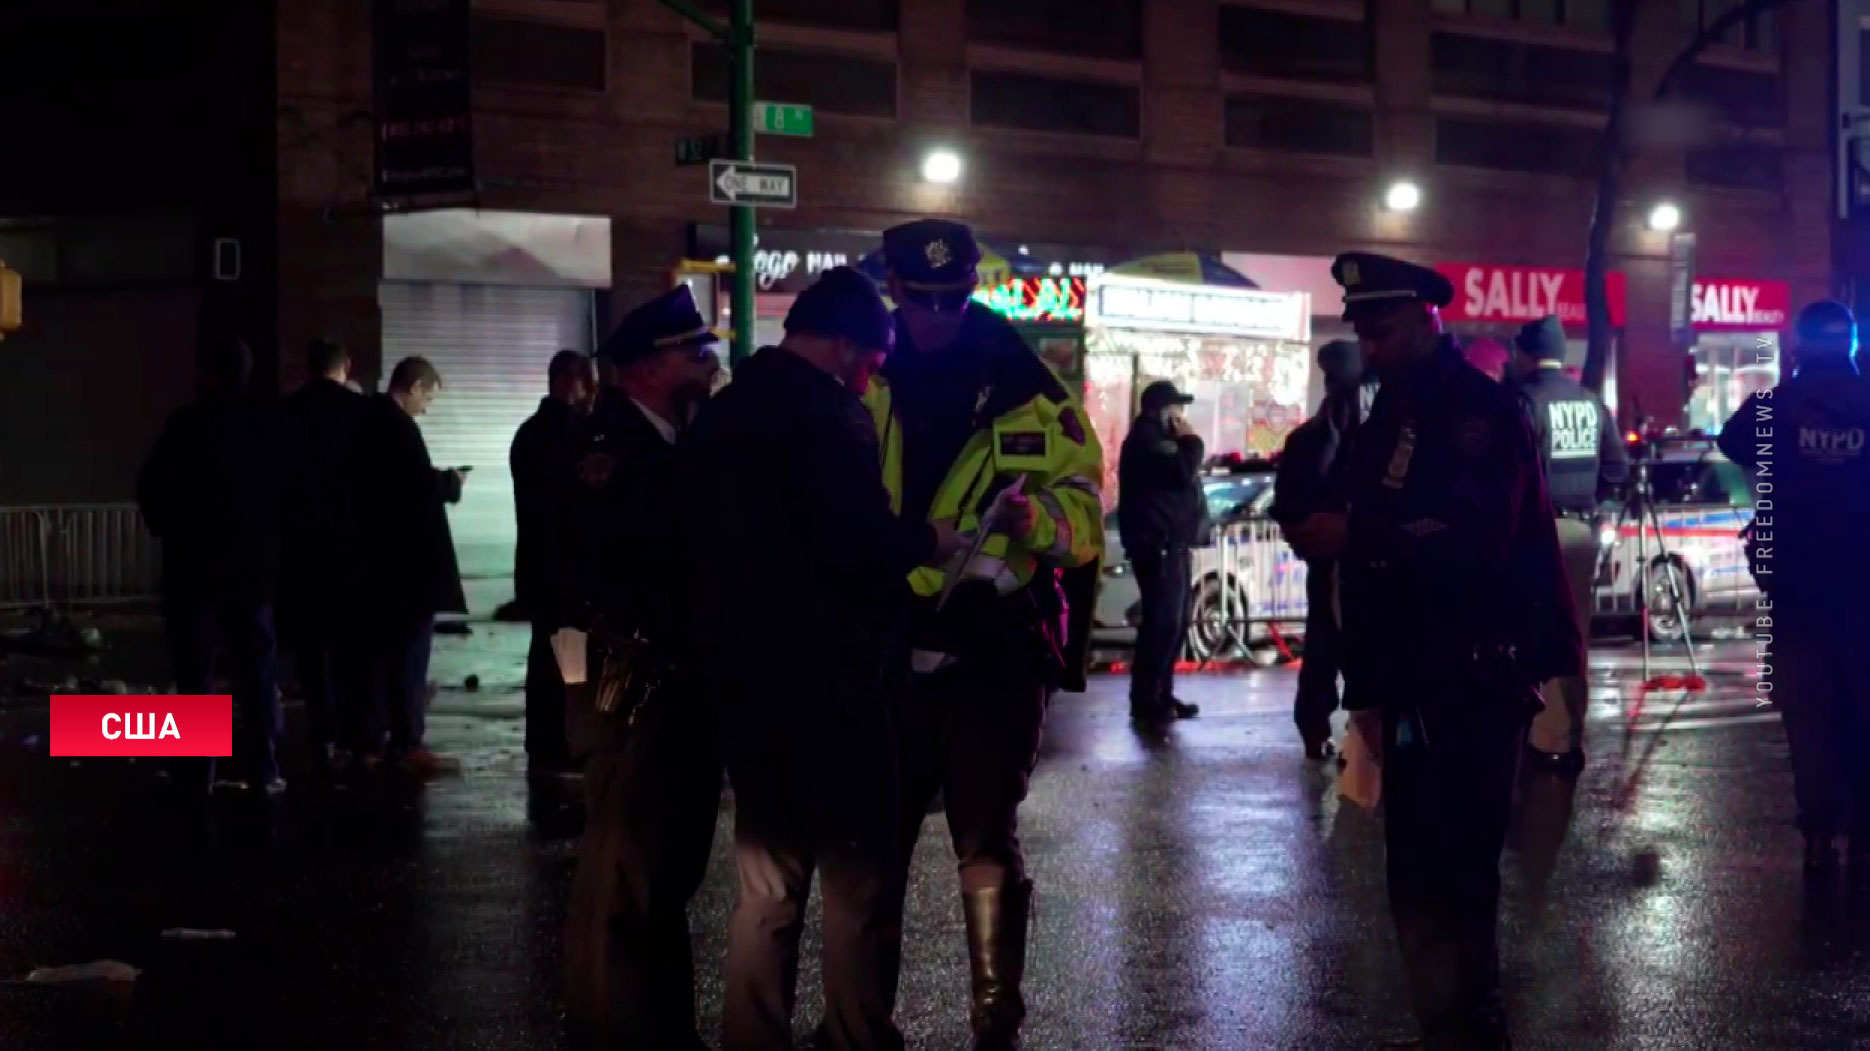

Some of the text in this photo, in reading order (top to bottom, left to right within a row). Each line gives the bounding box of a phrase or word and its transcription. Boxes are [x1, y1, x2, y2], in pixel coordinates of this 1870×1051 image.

[725, 175, 785, 190] ONE WAY
[1464, 266, 1565, 319] SALLY
[1690, 283, 1759, 325] SALLY
[1548, 400, 1598, 430] NYPD
[1551, 428, 1598, 450] POLICE
[1798, 426, 1865, 450] NYPD
